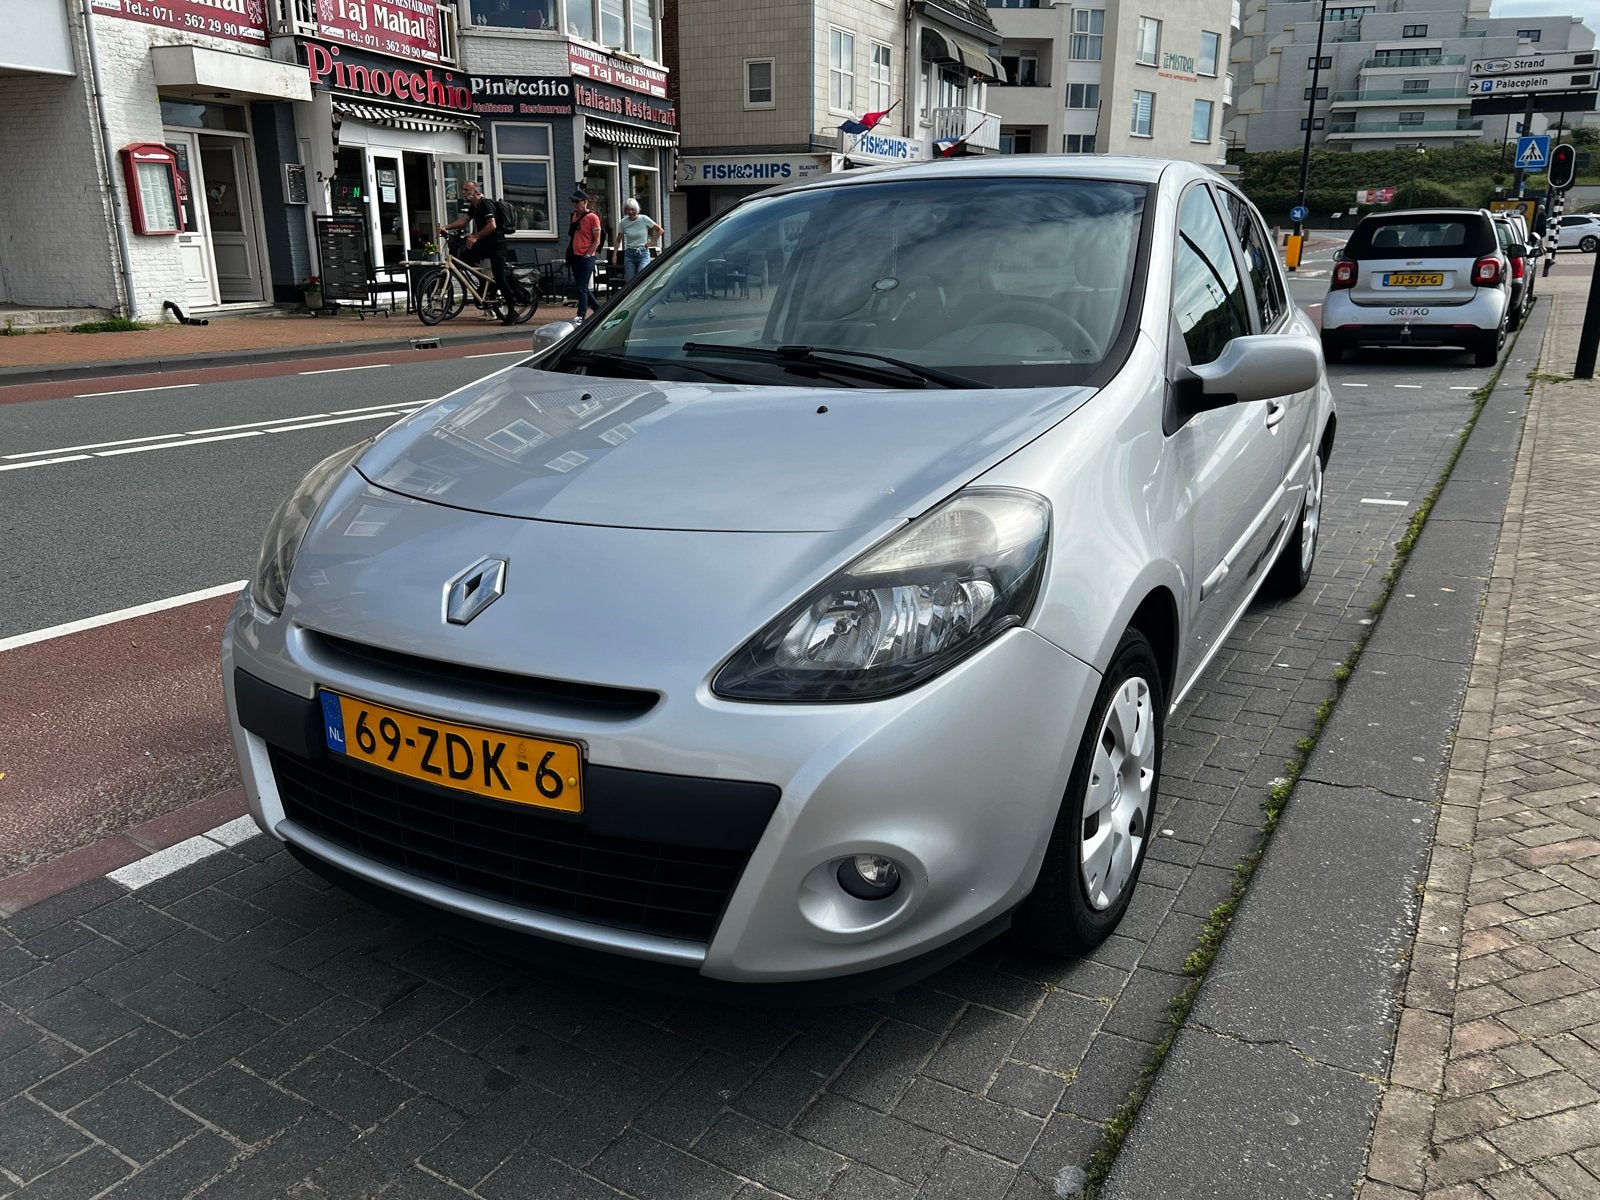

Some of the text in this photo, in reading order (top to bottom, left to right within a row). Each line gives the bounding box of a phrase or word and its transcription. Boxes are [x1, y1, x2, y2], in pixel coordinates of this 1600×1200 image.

[124, 0, 149, 17] Tel.:
[152, 6, 174, 22] 071
[184, 13, 205, 29] 362
[208, 18, 222, 32] 29
[224, 22, 237, 36] 90
[339, 0, 426, 39] Taj Mahal
[345, 29, 363, 43] Tel.:
[365, 34, 379, 47] 071
[386, 40, 400, 52] 362
[401, 44, 410, 55] 29
[411, 46, 420, 58] 90
[570, 45, 608, 65] AUTHENTIEK
[632, 64, 666, 82] RESTAURANT
[1513, 59, 1545, 68] Strand
[303, 41, 472, 110] Pinocchio
[470, 77, 569, 96] Pinocchio
[591, 64, 612, 82] Taj
[615, 71, 650, 91] Mahal
[1496, 78, 1548, 88] Palaceplein
[473, 103, 571, 114] Italiaans Restaurant
[575, 84, 676, 125] Italiaans Restaurant
[703, 163, 791, 179] FISH&CHIPS
[1393, 275, 1438, 284] JJ-576-G
[1389, 307, 1430, 316] GROKO
[329, 726, 344, 743] NL
[356, 710, 564, 799] 69-ZDK-6
